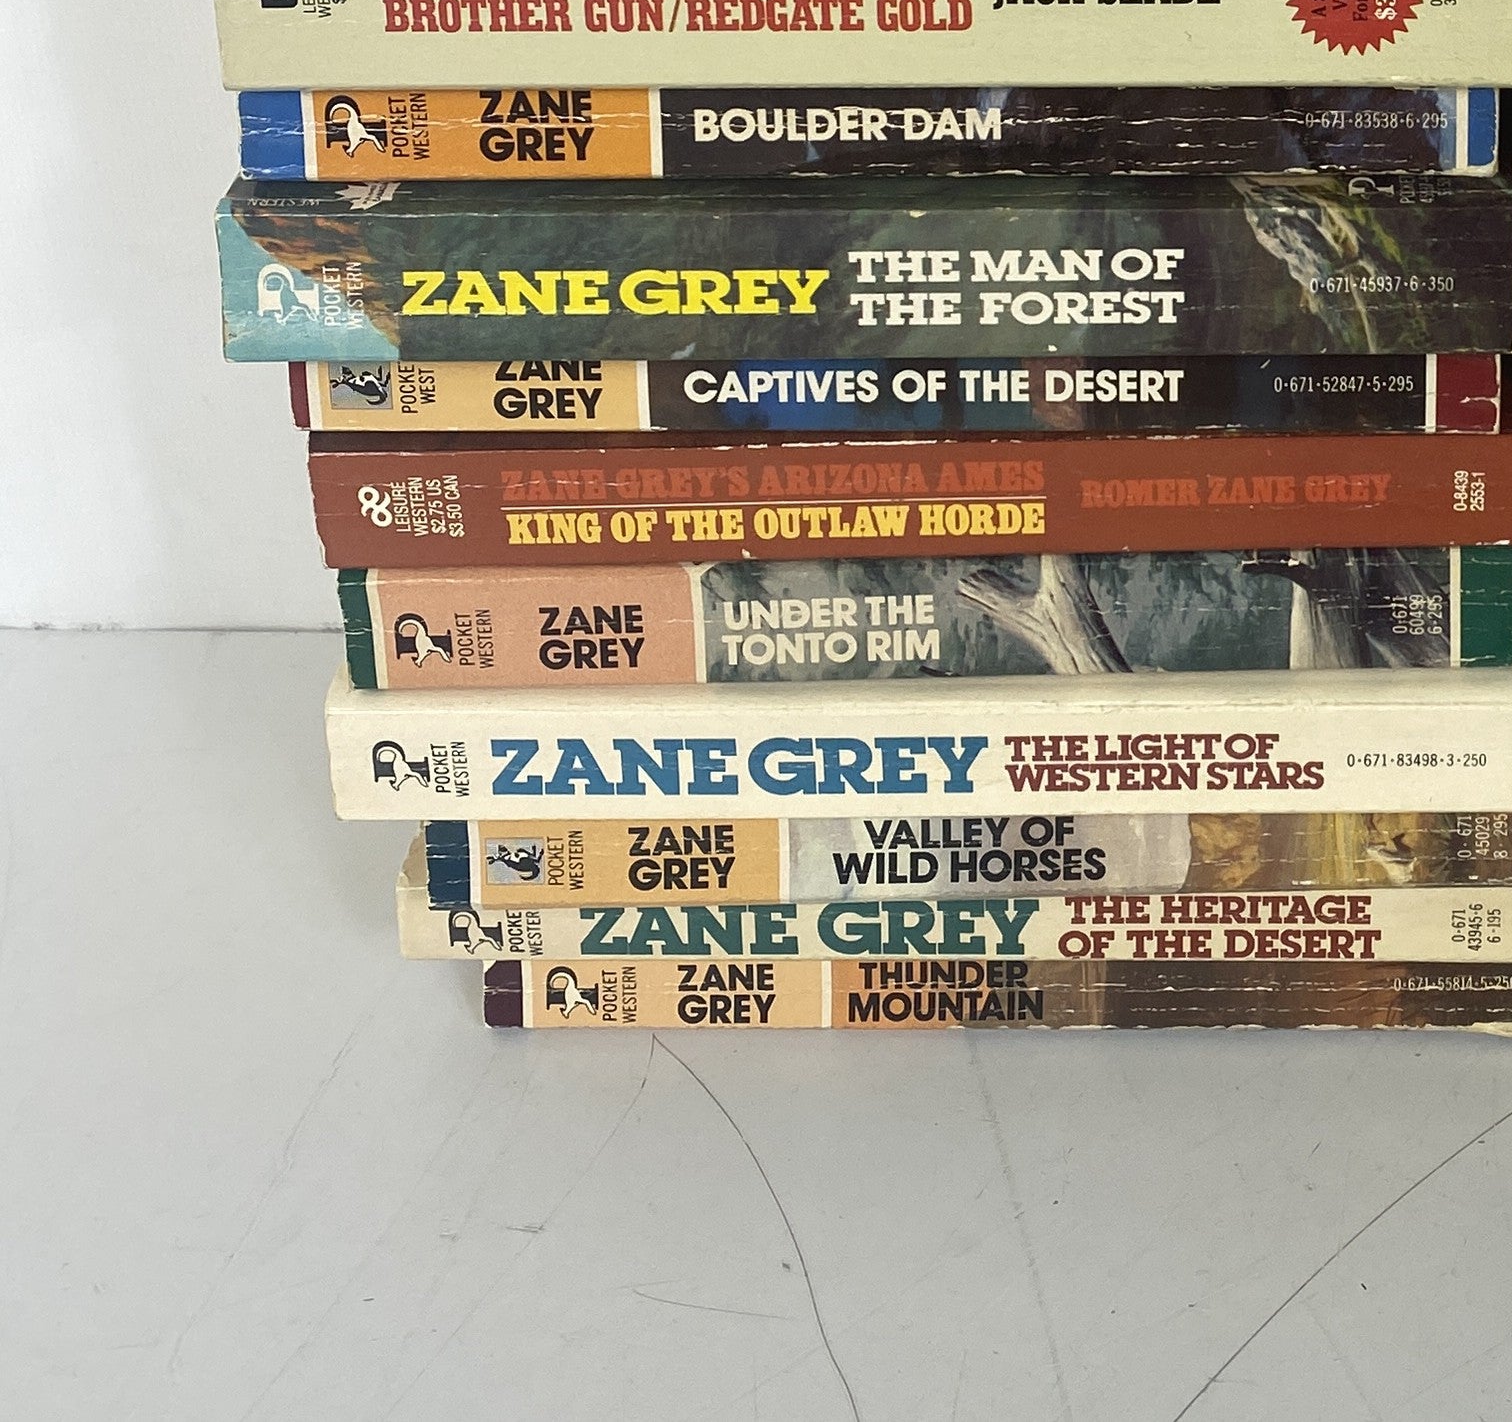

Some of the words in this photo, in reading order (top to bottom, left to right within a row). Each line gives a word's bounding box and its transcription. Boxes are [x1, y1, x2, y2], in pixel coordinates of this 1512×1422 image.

[1311, 6, 1326, 17] A
[694, 108, 888, 143] BOULDER
[904, 107, 1003, 140] DAM
[426, 479, 440, 496] US
[443, 475, 461, 500] CAN
[502, 468, 599, 502] ZANE
[606, 467, 747, 499] GREY'S
[756, 462, 928, 497] ARIZONA
[934, 461, 1046, 492] AMES
[1080, 478, 1200, 509] ROMER
[1207, 475, 1294, 505] ZANE
[1306, 474, 1392, 503] GREY
[1453, 471, 1469, 511] 0-8439
[1470, 472, 1485, 511] 2553-1
[391, 482, 411, 532] LEISURE
[408, 477, 429, 537] WESTERN
[429, 500, 447, 534] $2.75
[446, 503, 464, 538] $3.50
[508, 509, 602, 546] KING
[610, 508, 660, 543] OF
[667, 506, 746, 541] THE
[754, 504, 908, 540] OUTLAW
[919, 502, 1046, 537] HORDE
[455, 613, 475, 666] POCKET
[475, 609, 493, 668] WESTERN
[863, 818, 1011, 849] VALLEY
[1021, 816, 1074, 846] OF
[833, 853, 939, 885] WILD
[950, 849, 1107, 882] HORSES
[858, 962, 1029, 988] THUNDER
[848, 991, 1044, 1023] MOUNTAIN
